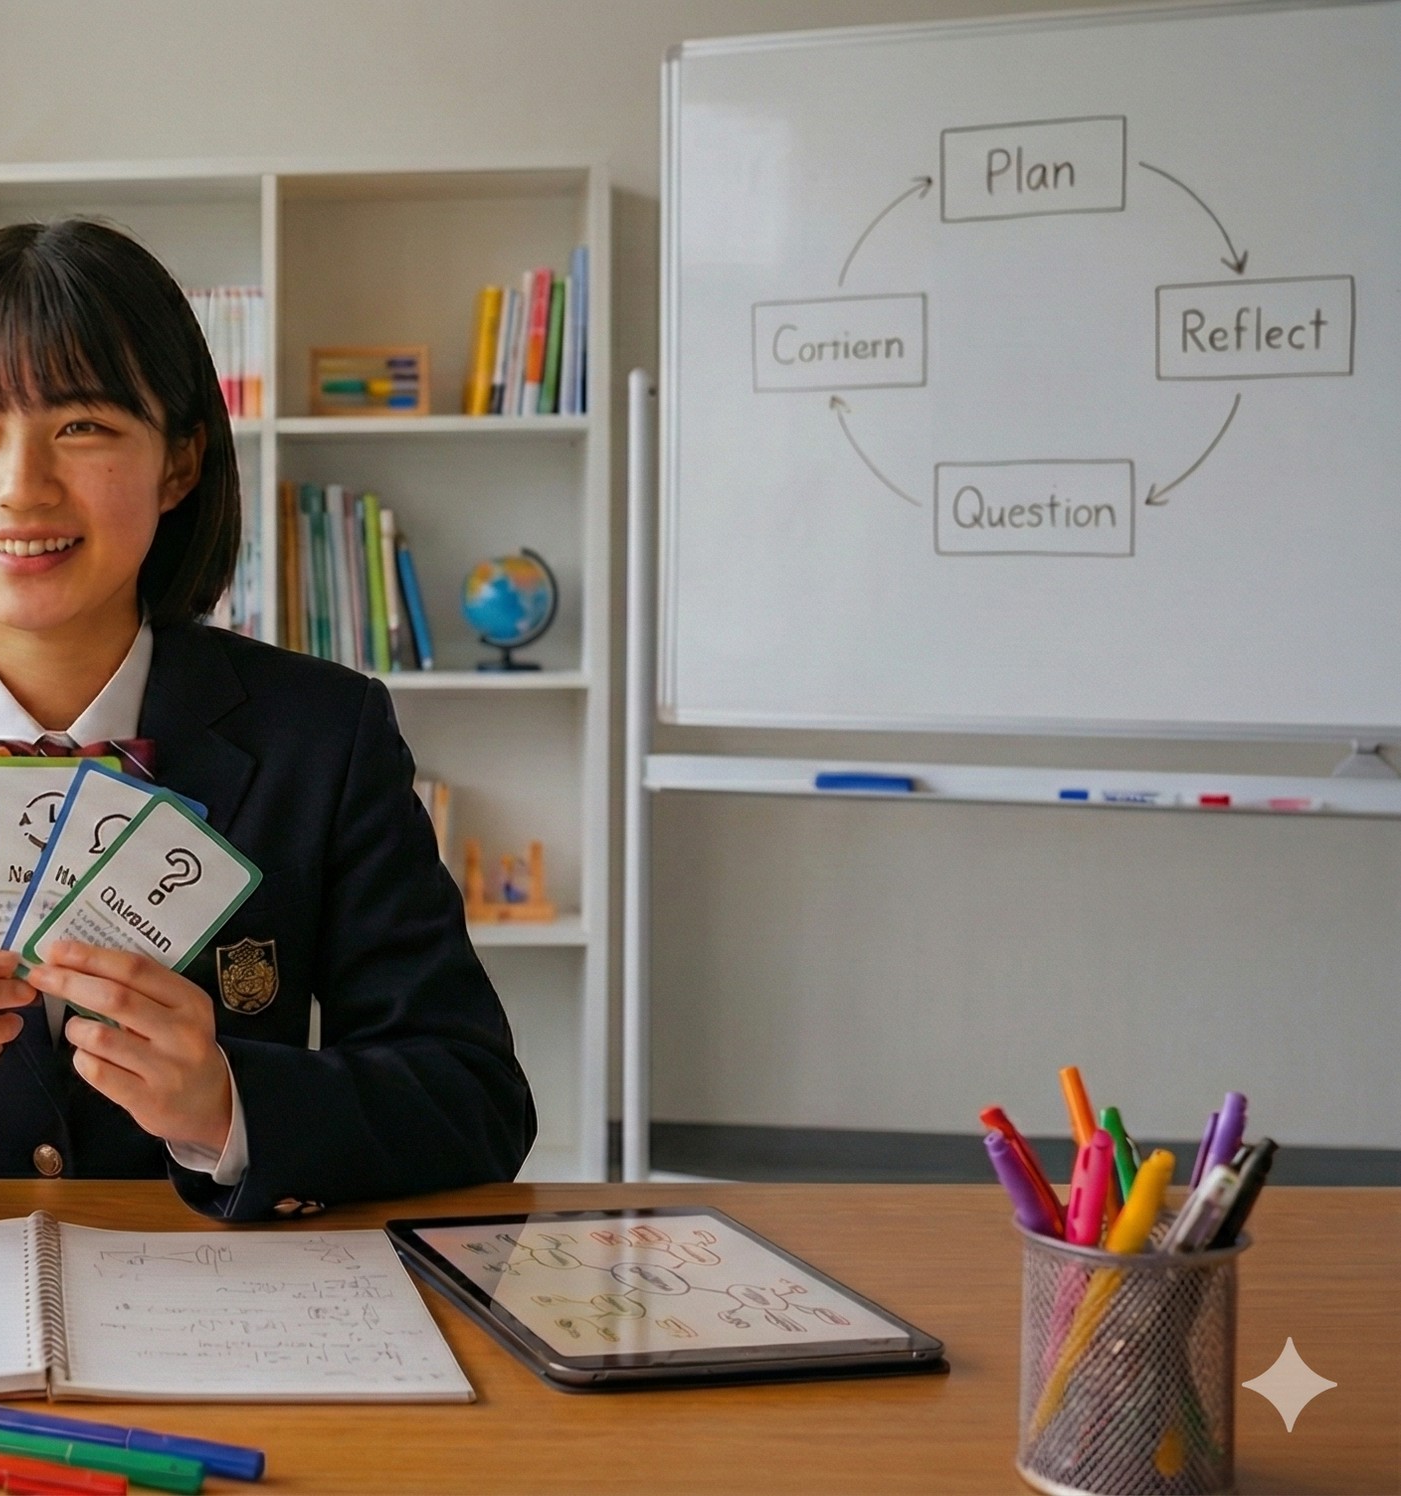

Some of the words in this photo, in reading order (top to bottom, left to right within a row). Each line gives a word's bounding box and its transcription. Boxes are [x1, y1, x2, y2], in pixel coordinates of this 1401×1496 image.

[986, 145, 1075, 194] Plan
[1181, 306, 1328, 352] Reflect
[952, 485, 1117, 529] Question
